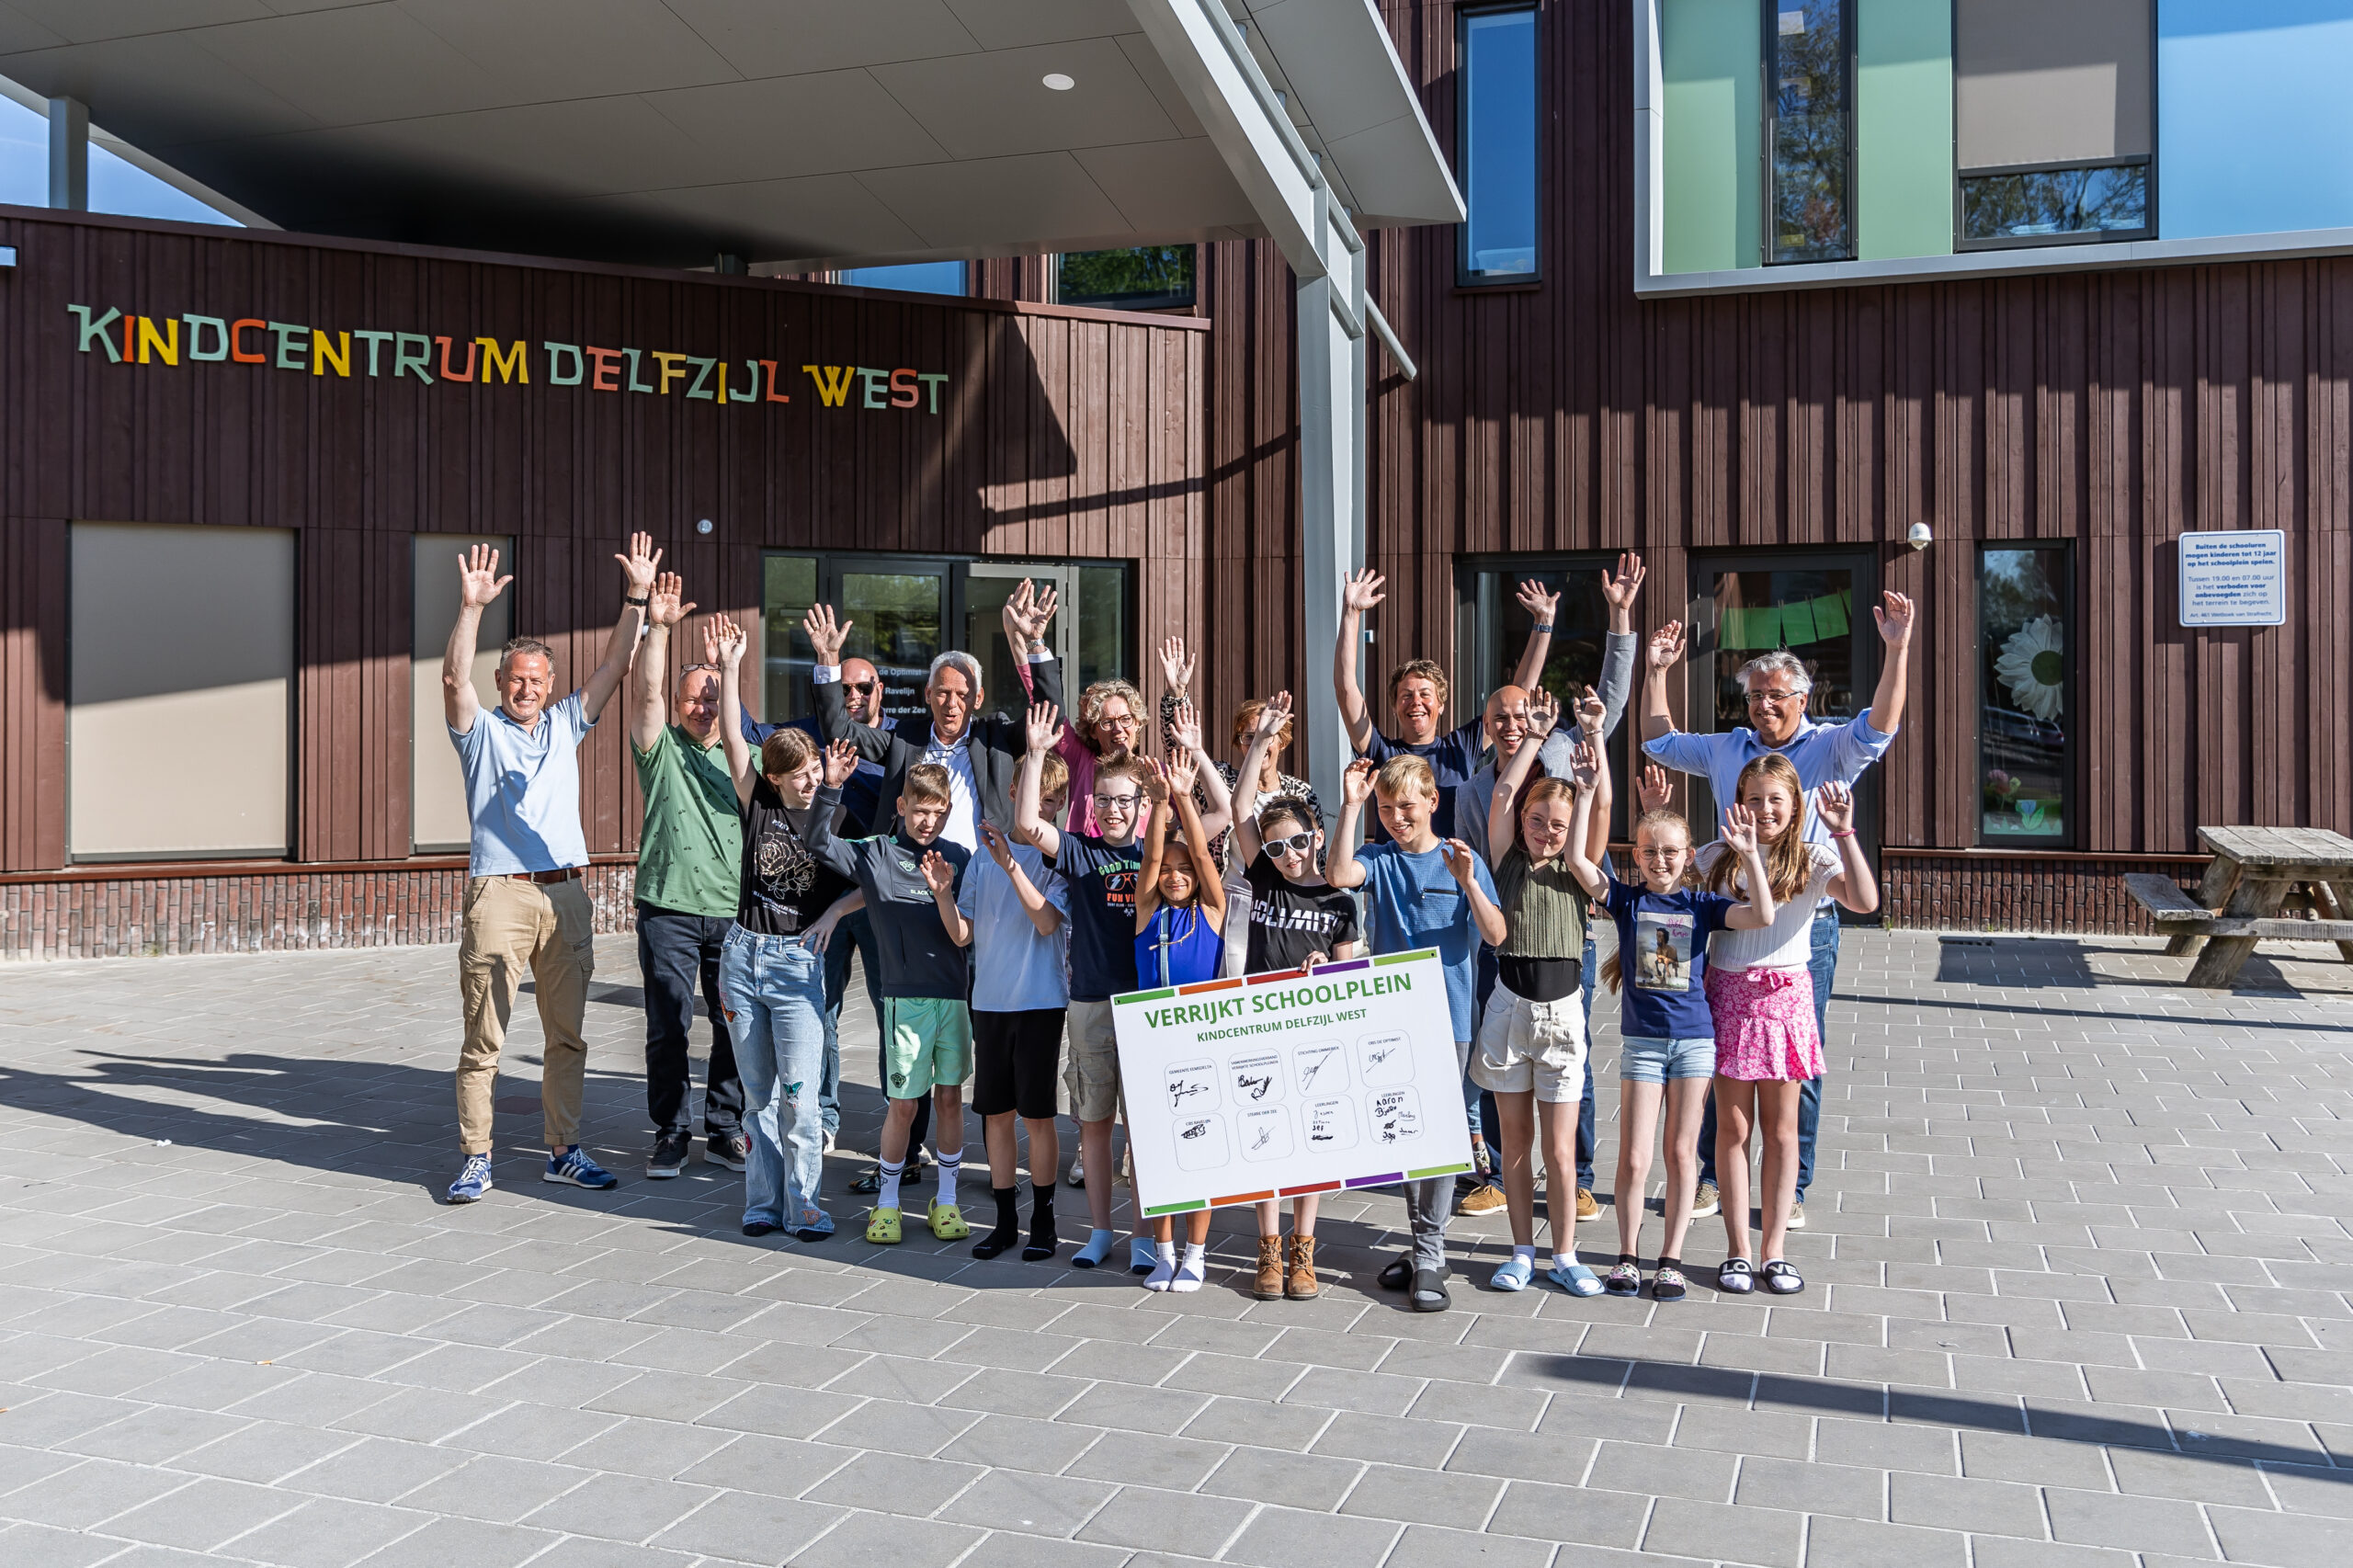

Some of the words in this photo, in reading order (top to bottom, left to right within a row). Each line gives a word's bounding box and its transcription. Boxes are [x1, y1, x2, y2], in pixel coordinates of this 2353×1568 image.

[67, 302, 529, 385] KINDCENTRUM
[544, 341, 790, 404] DELFZIJL
[802, 364, 949, 415] WEST
[890, 668, 922, 676] Optimist
[884, 687, 915, 697] Ravelijn
[1098, 861, 1121, 876] GOOD
[1123, 859, 1141, 870] TIM
[1107, 892, 1123, 903] FUN
[1144, 997, 1245, 1028] VERRIJKT
[1252, 972, 1412, 1014] SCHOOLPLEIN
[1197, 1021, 1282, 1042] KINDCENTRUM
[1285, 1015, 1334, 1030] DELFZIJL
[1336, 1008, 1368, 1022] WEST
